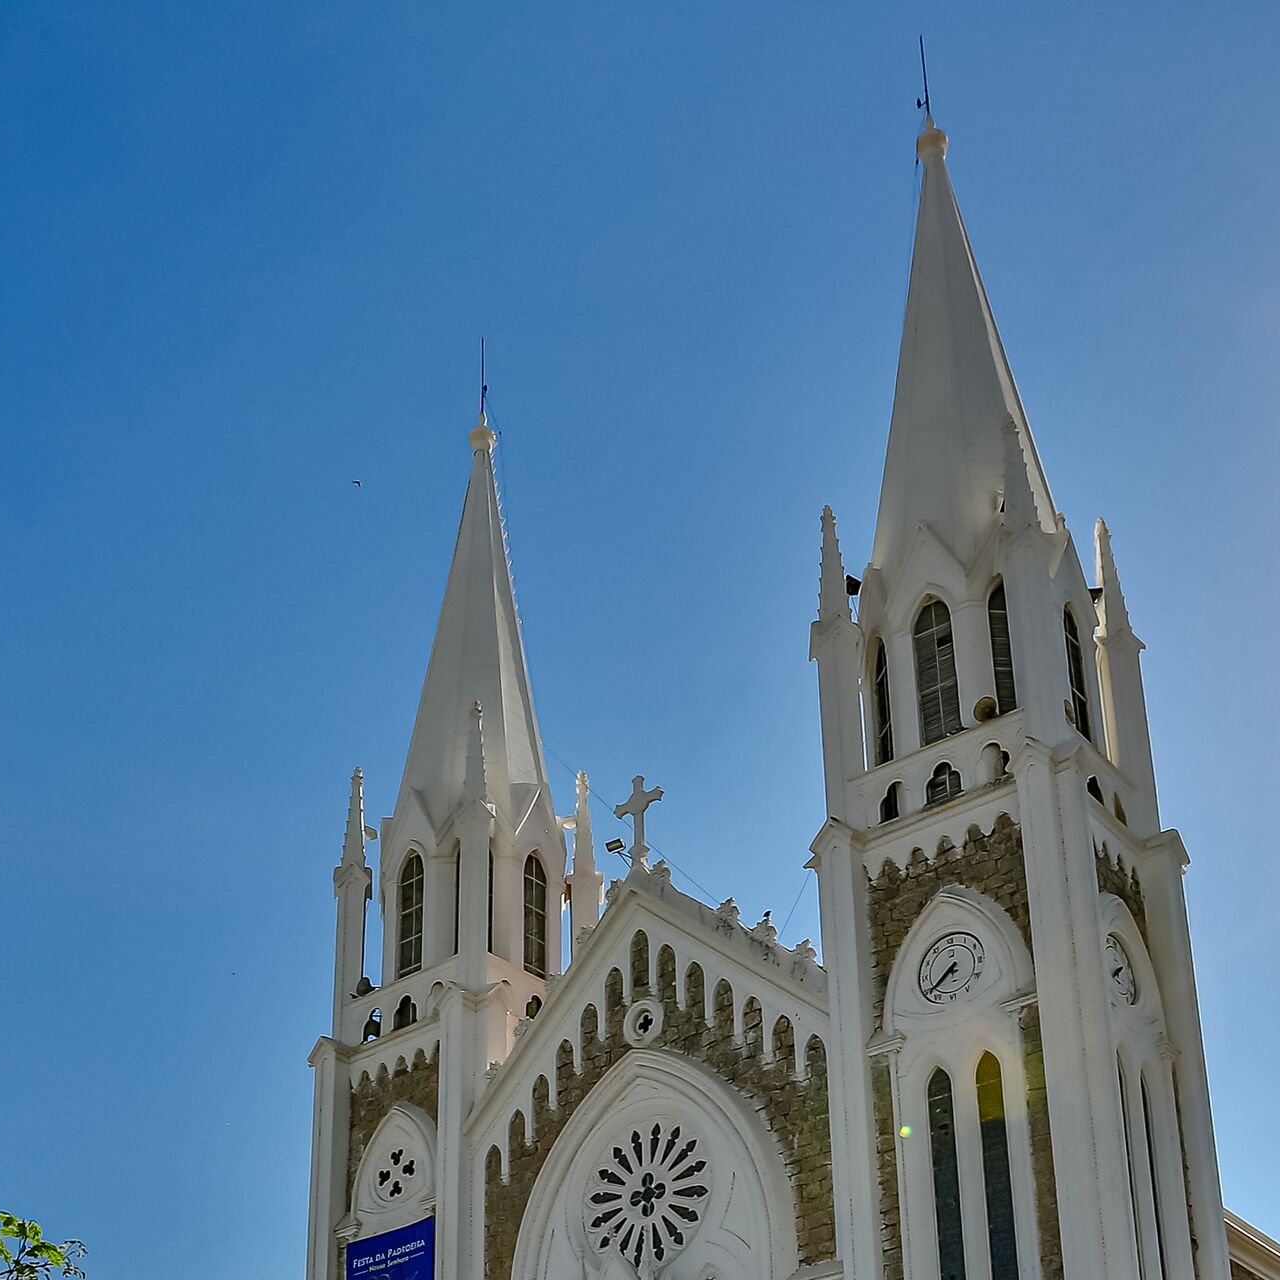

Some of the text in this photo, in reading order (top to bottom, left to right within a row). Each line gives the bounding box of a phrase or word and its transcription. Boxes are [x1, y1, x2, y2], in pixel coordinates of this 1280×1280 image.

[353, 1239, 426, 1269] FESTA DA PADROEIRA
[387, 1256, 410, 1267] Senhora
